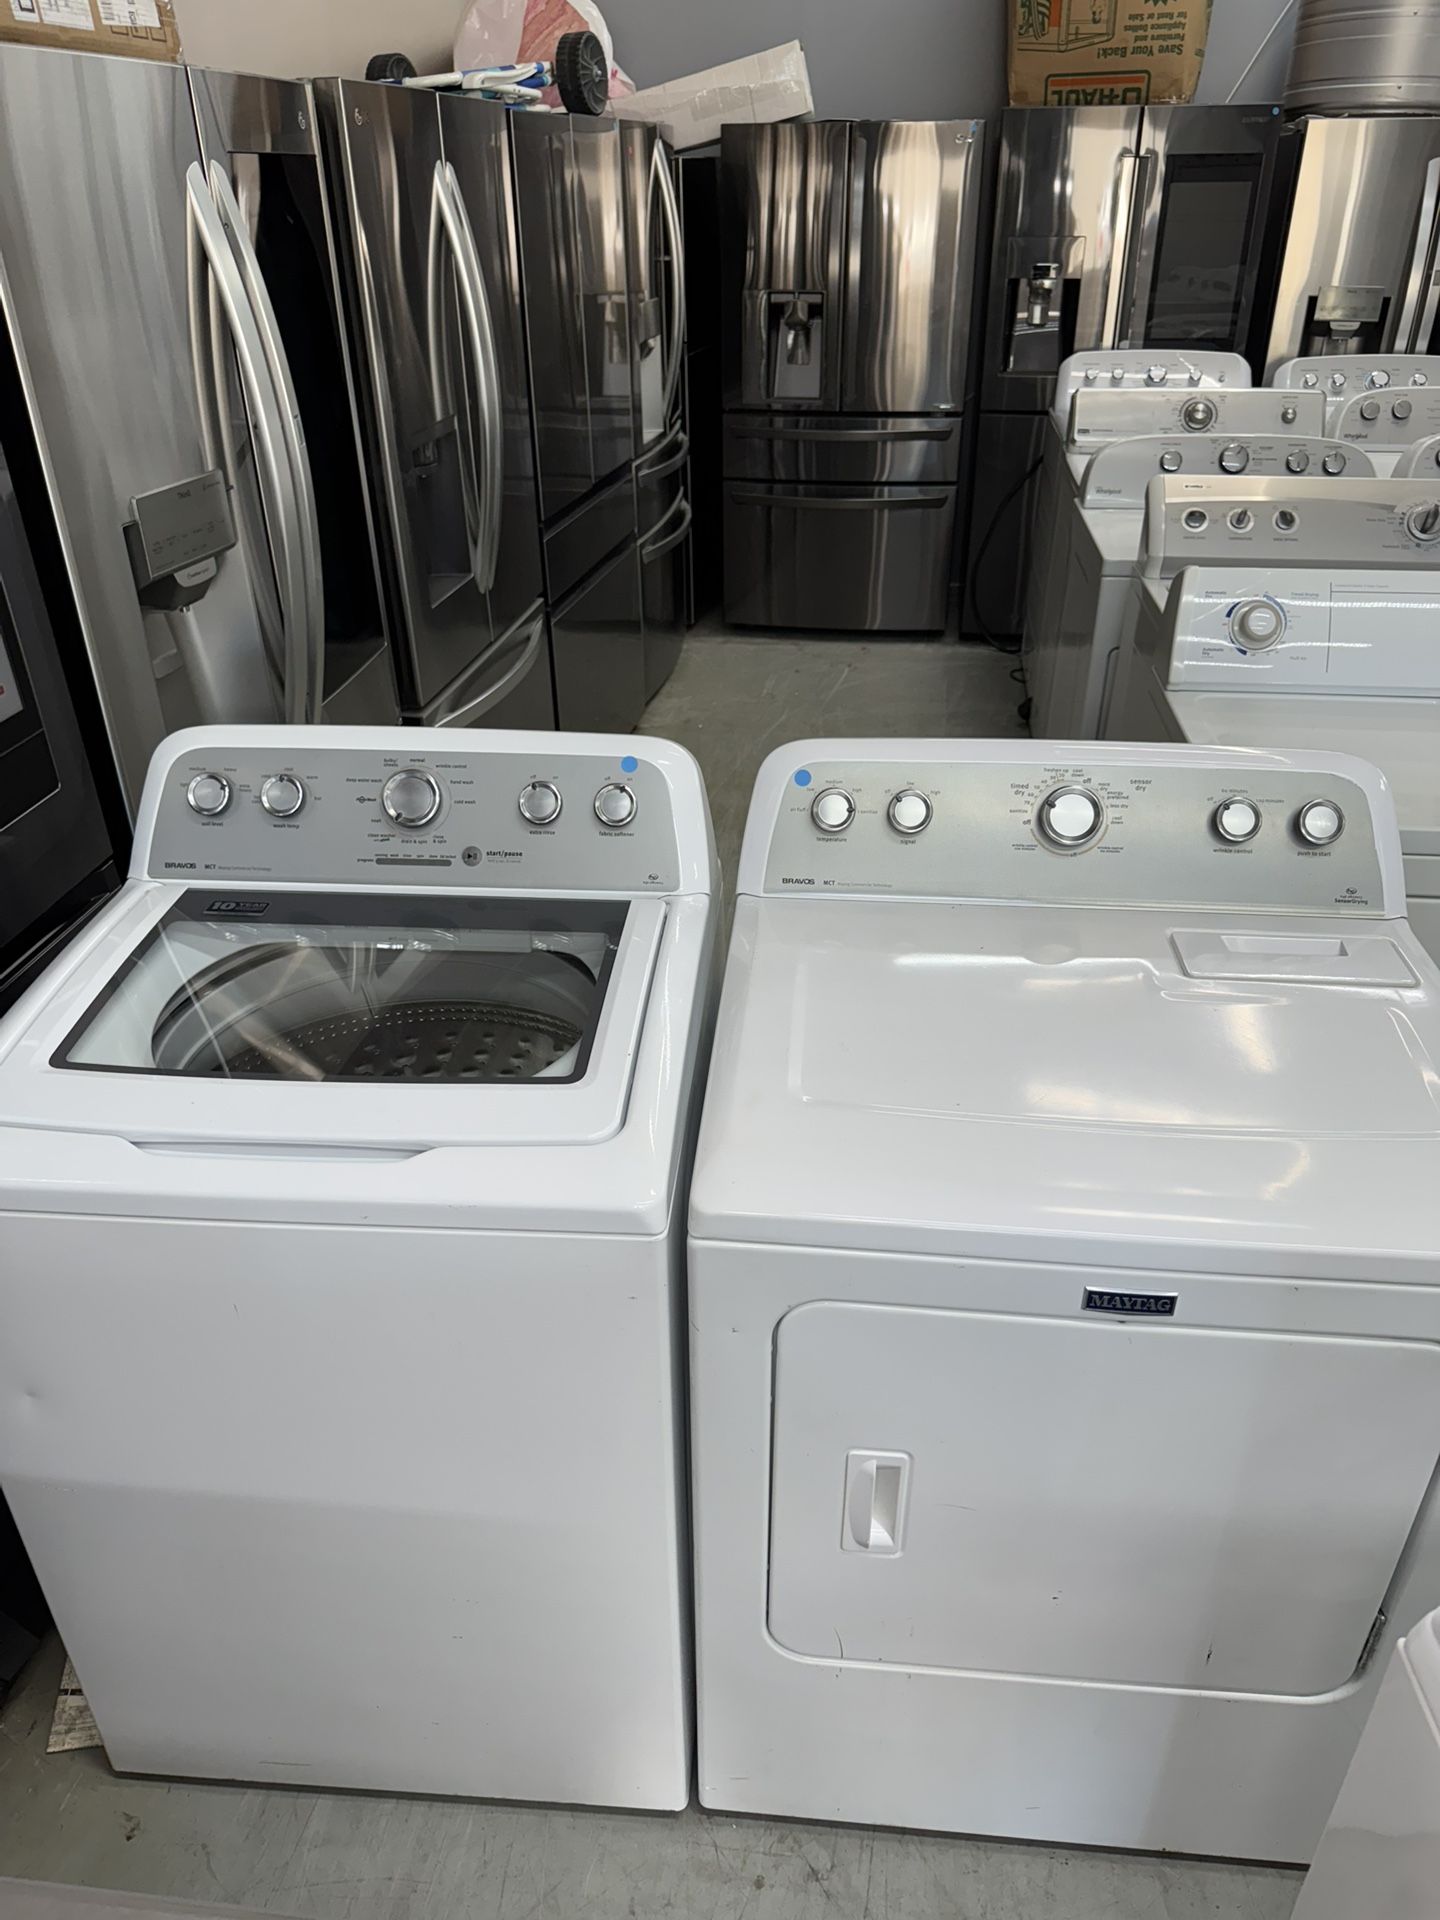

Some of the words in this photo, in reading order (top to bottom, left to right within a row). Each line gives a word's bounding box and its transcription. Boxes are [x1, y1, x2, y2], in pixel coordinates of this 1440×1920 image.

[1128, 13, 1145, 22] Sale
[1177, 11, 1187, 20] for
[1123, 24, 1148, 33] Dollies
[1150, 21, 1187, 31] Appliance
[1133, 35, 1149, 43] and
[1150, 33, 1185, 42] Furniture
[1097, 46, 1128, 59] Back!
[1130, 45, 1154, 57] Your
[1158, 44, 1184, 56] Save
[1014, 789, 1025, 797] dry
[486, 849, 523, 858] start/pause
[164, 862, 197, 870] BRAVOS
[782, 878, 815, 886] BRAVOS
[211, 902, 236, 910] 10
[1334, 898, 1368, 906] SensorDrying
[1090, 1294, 1172, 1312] MAYTAG
